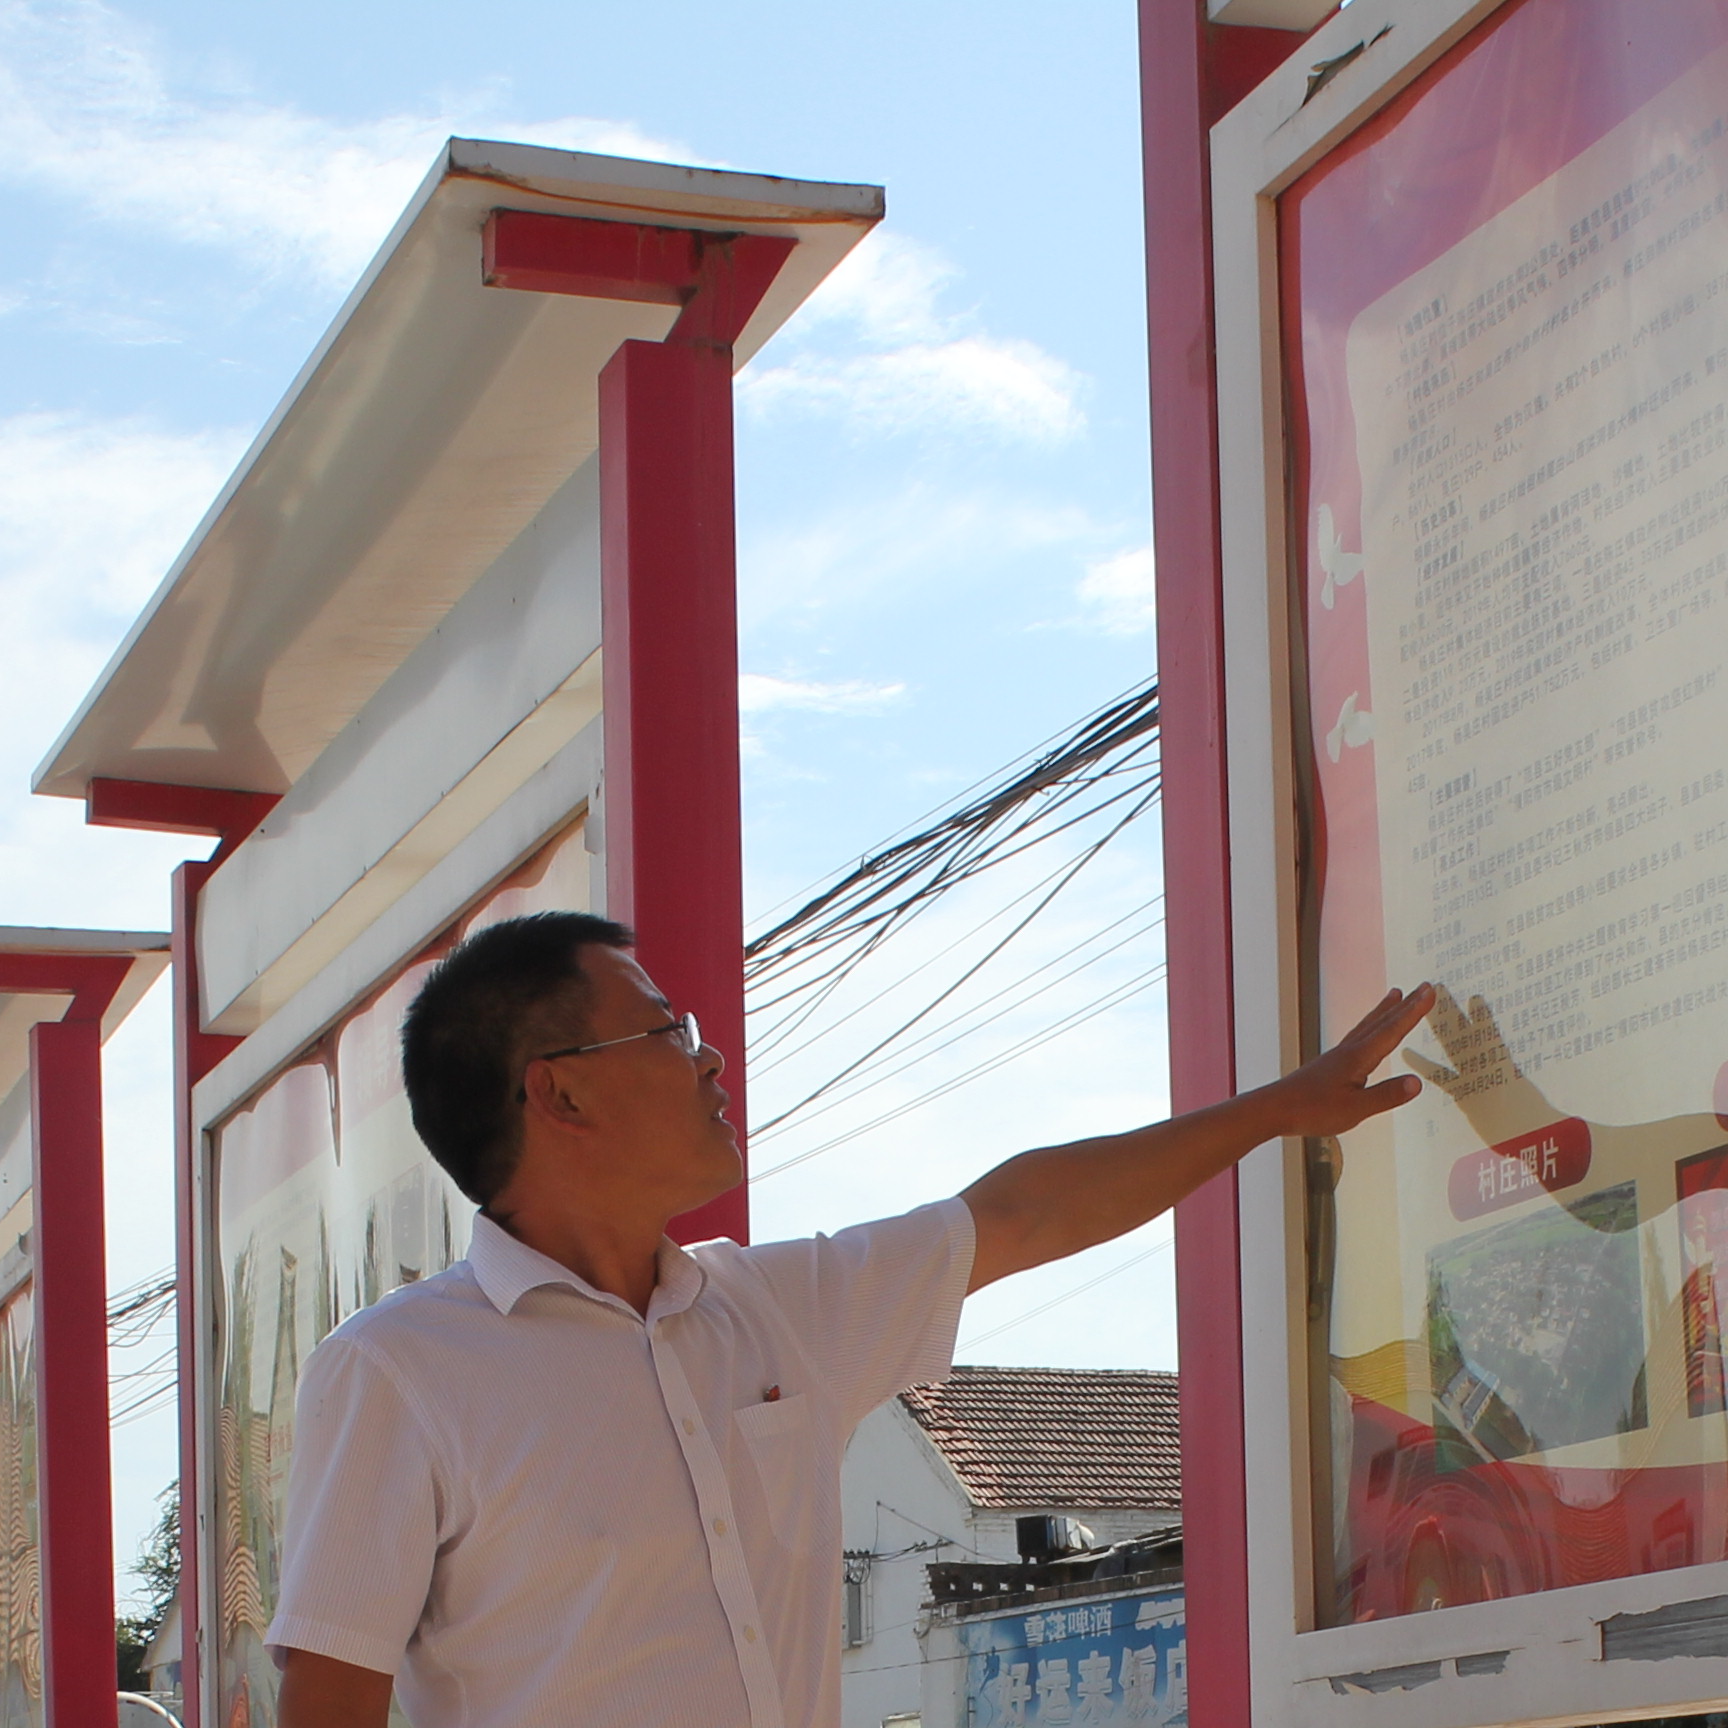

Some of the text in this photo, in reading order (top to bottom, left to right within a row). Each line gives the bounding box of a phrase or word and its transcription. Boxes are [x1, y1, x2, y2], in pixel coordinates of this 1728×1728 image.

[1478, 1137, 1560, 1203] 村庄照片
[1023, 1603, 1113, 1648] 雪花啤酒
